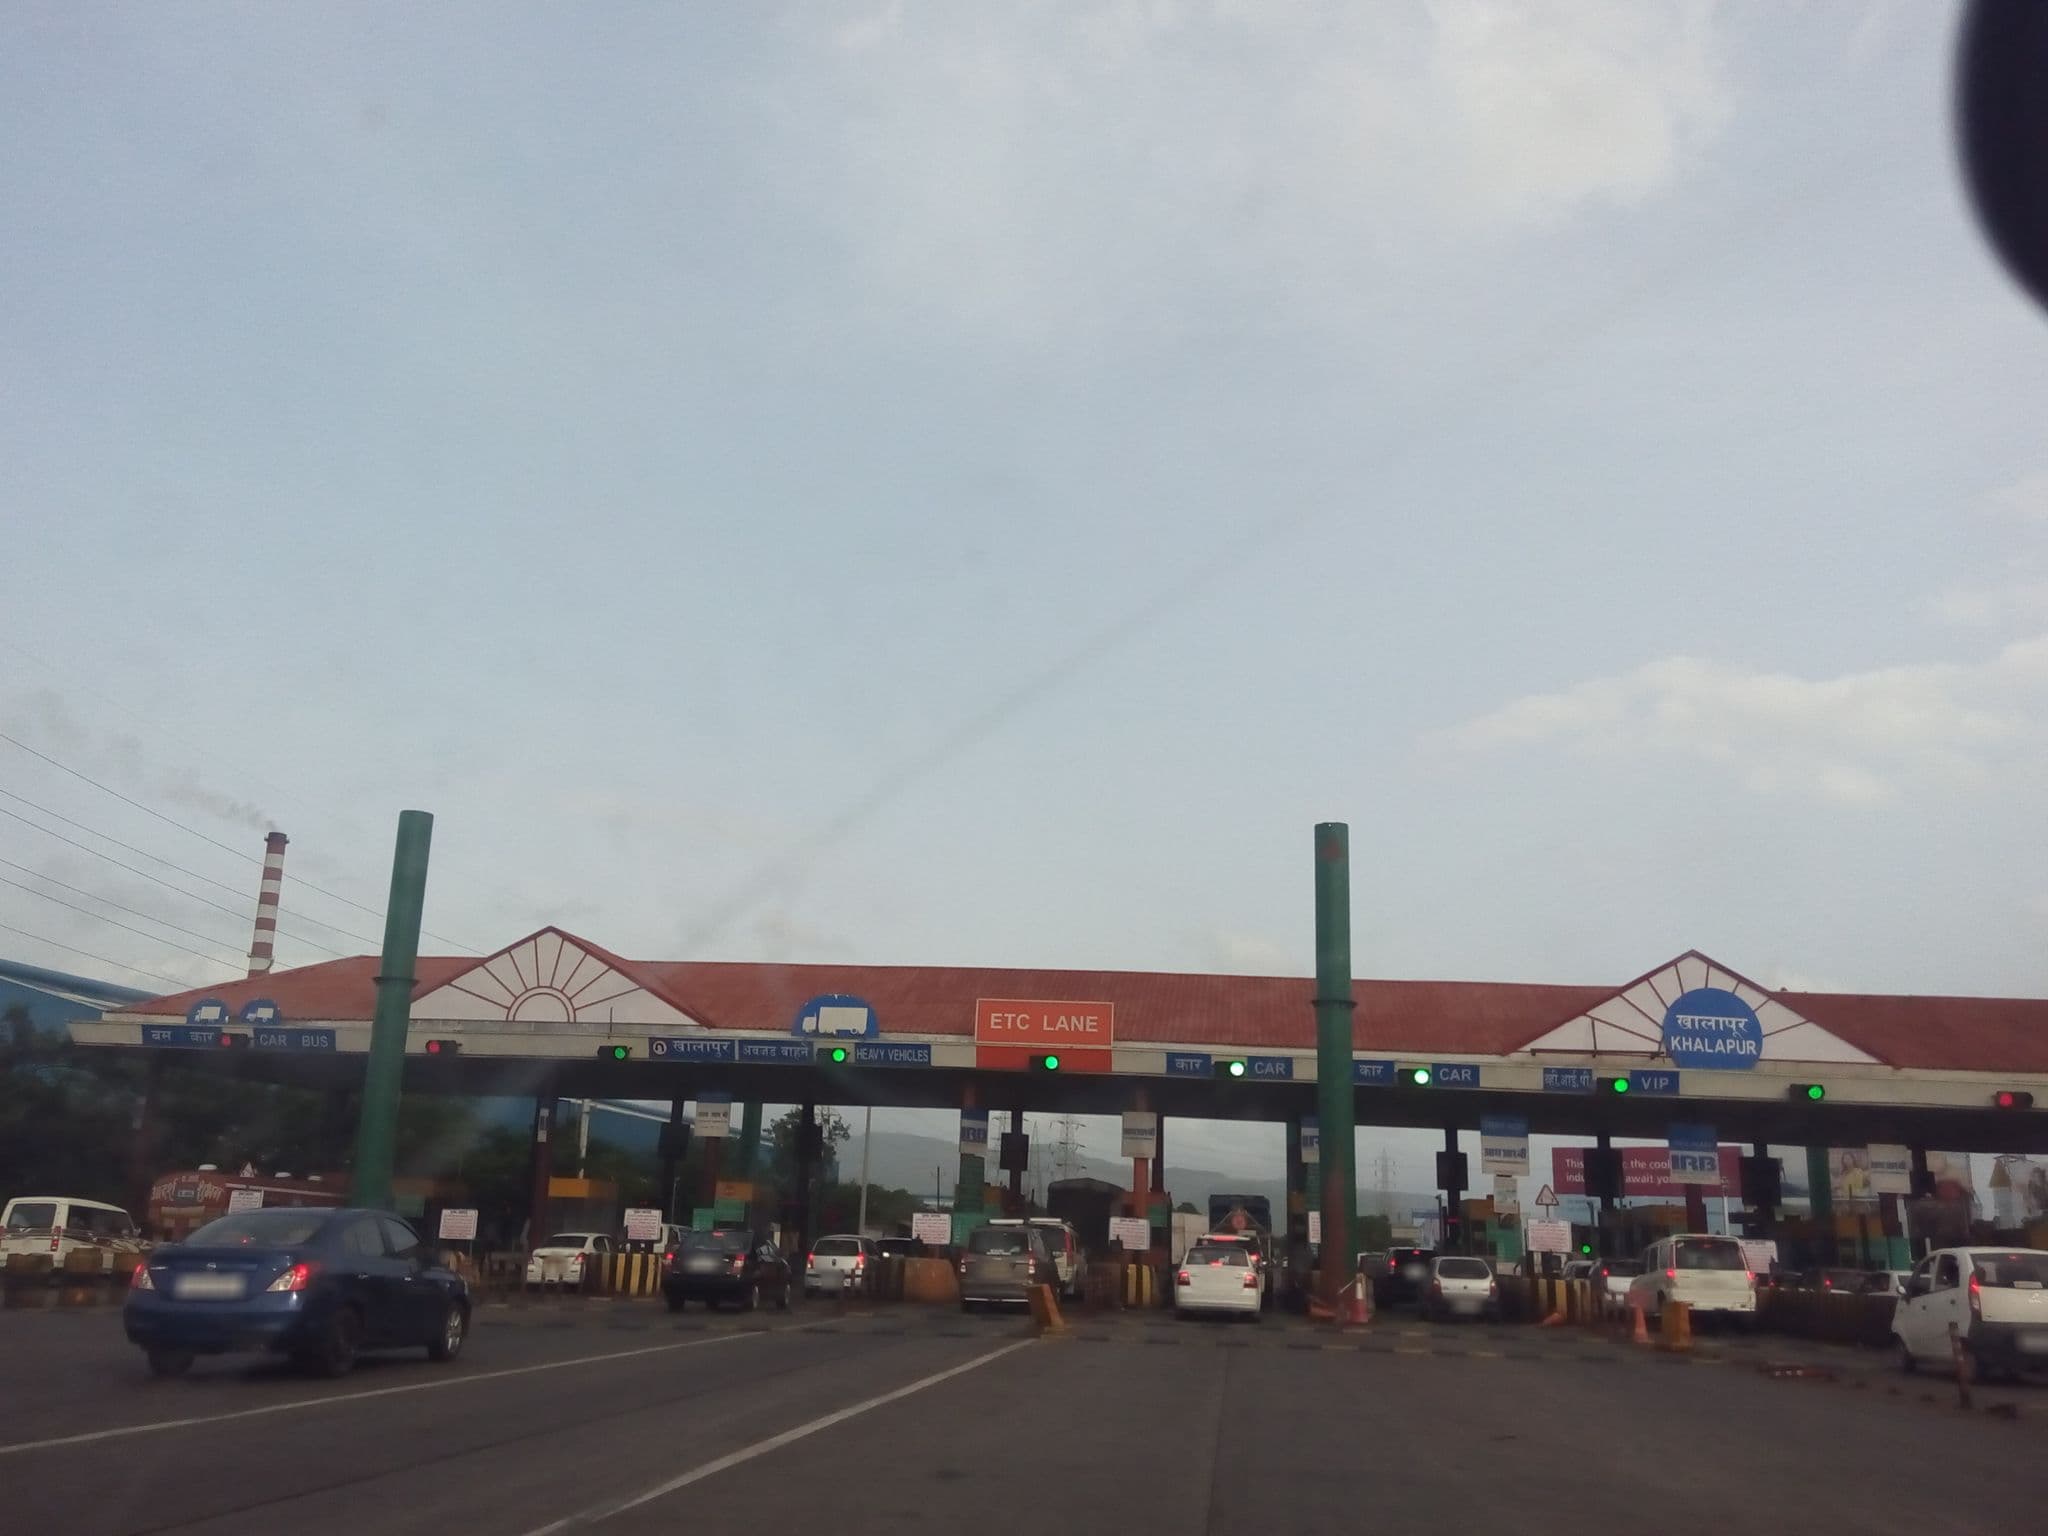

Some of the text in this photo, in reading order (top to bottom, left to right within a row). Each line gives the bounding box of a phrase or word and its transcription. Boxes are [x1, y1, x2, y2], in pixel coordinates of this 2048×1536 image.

[990, 1012, 1099, 1033] ETC LANE
[1676, 1014, 1749, 1039] खालापूर
[259, 1034, 329, 1048] CAR BUS
[1670, 1036, 1757, 1055] KHALAPUR
[856, 1048, 929, 1062] HEAVY VEHICLES
[1175, 1058, 1203, 1071] कार
[1254, 1062, 1286, 1075] CAR
[1359, 1064, 1384, 1078] कार
[1439, 1068, 1472, 1081] CAR
[1641, 1076, 1669, 1091] VIP
[1565, 1159, 1584, 1169] This
[1630, 1158, 1647, 1169] the
[1671, 1154, 1717, 1171] IRB
[1625, 1174, 1654, 1184] await
